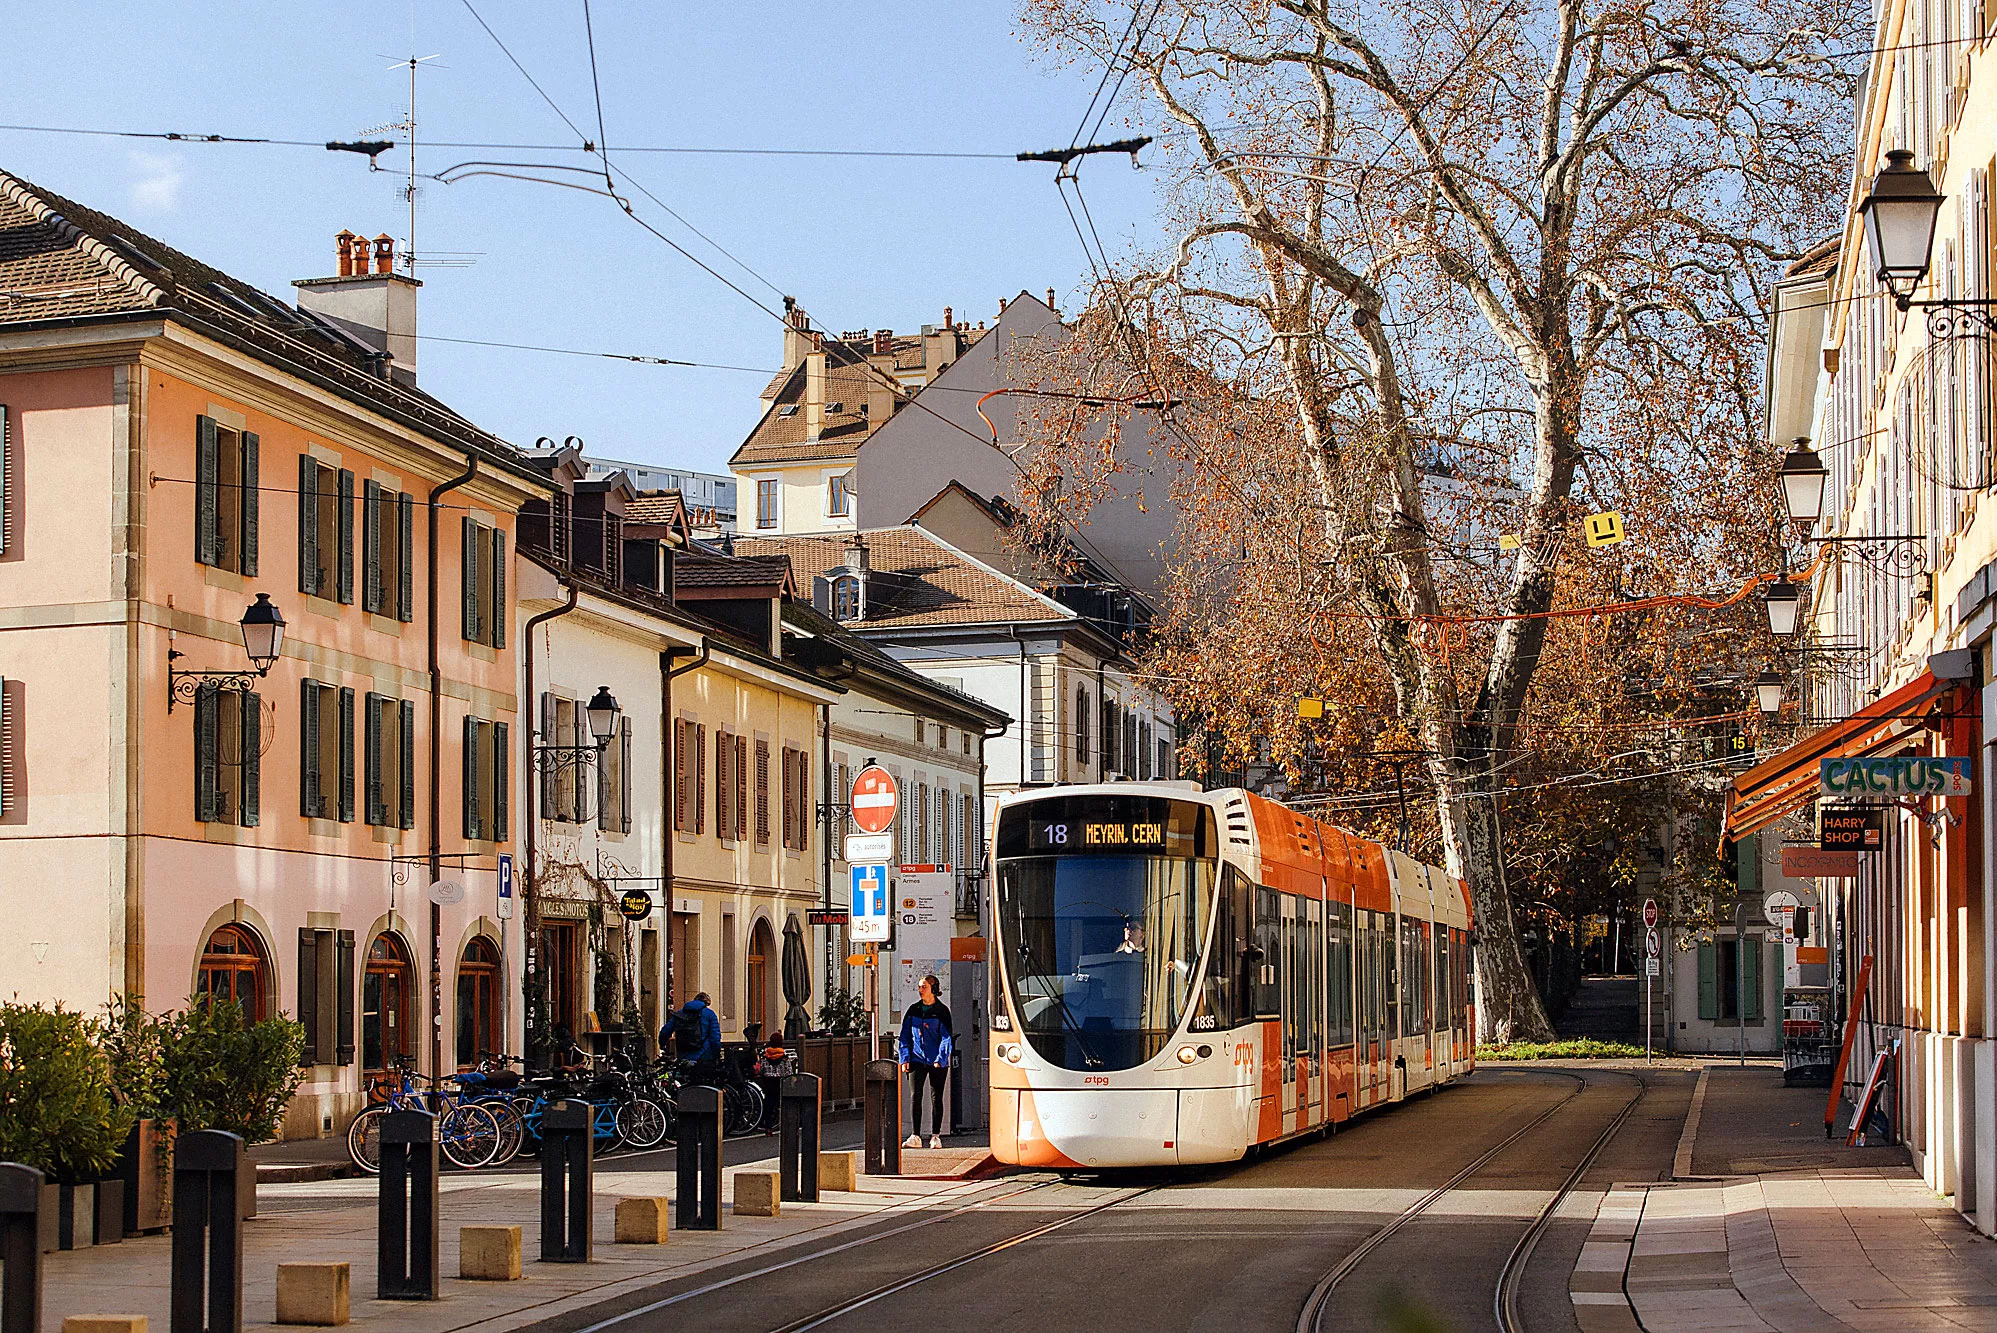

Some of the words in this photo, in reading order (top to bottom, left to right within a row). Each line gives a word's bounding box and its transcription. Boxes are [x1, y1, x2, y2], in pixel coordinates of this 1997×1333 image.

[1732, 736, 1745, 750] 15
[1825, 760, 1945, 793] CACTUS
[1952, 761, 1963, 791] SPORTS
[1824, 818, 1866, 829] HARRY
[1043, 824, 1068, 844] 18
[1085, 823, 1129, 844] MEYRIN,
[1132, 823, 1161, 844] CERN
[1825, 832, 1860, 843] SHOP
[502, 862, 510, 894] P
[904, 915, 915, 923] 18
[1646, 908, 1656, 919] STOP
[1195, 1015, 1215, 1029] 1835
